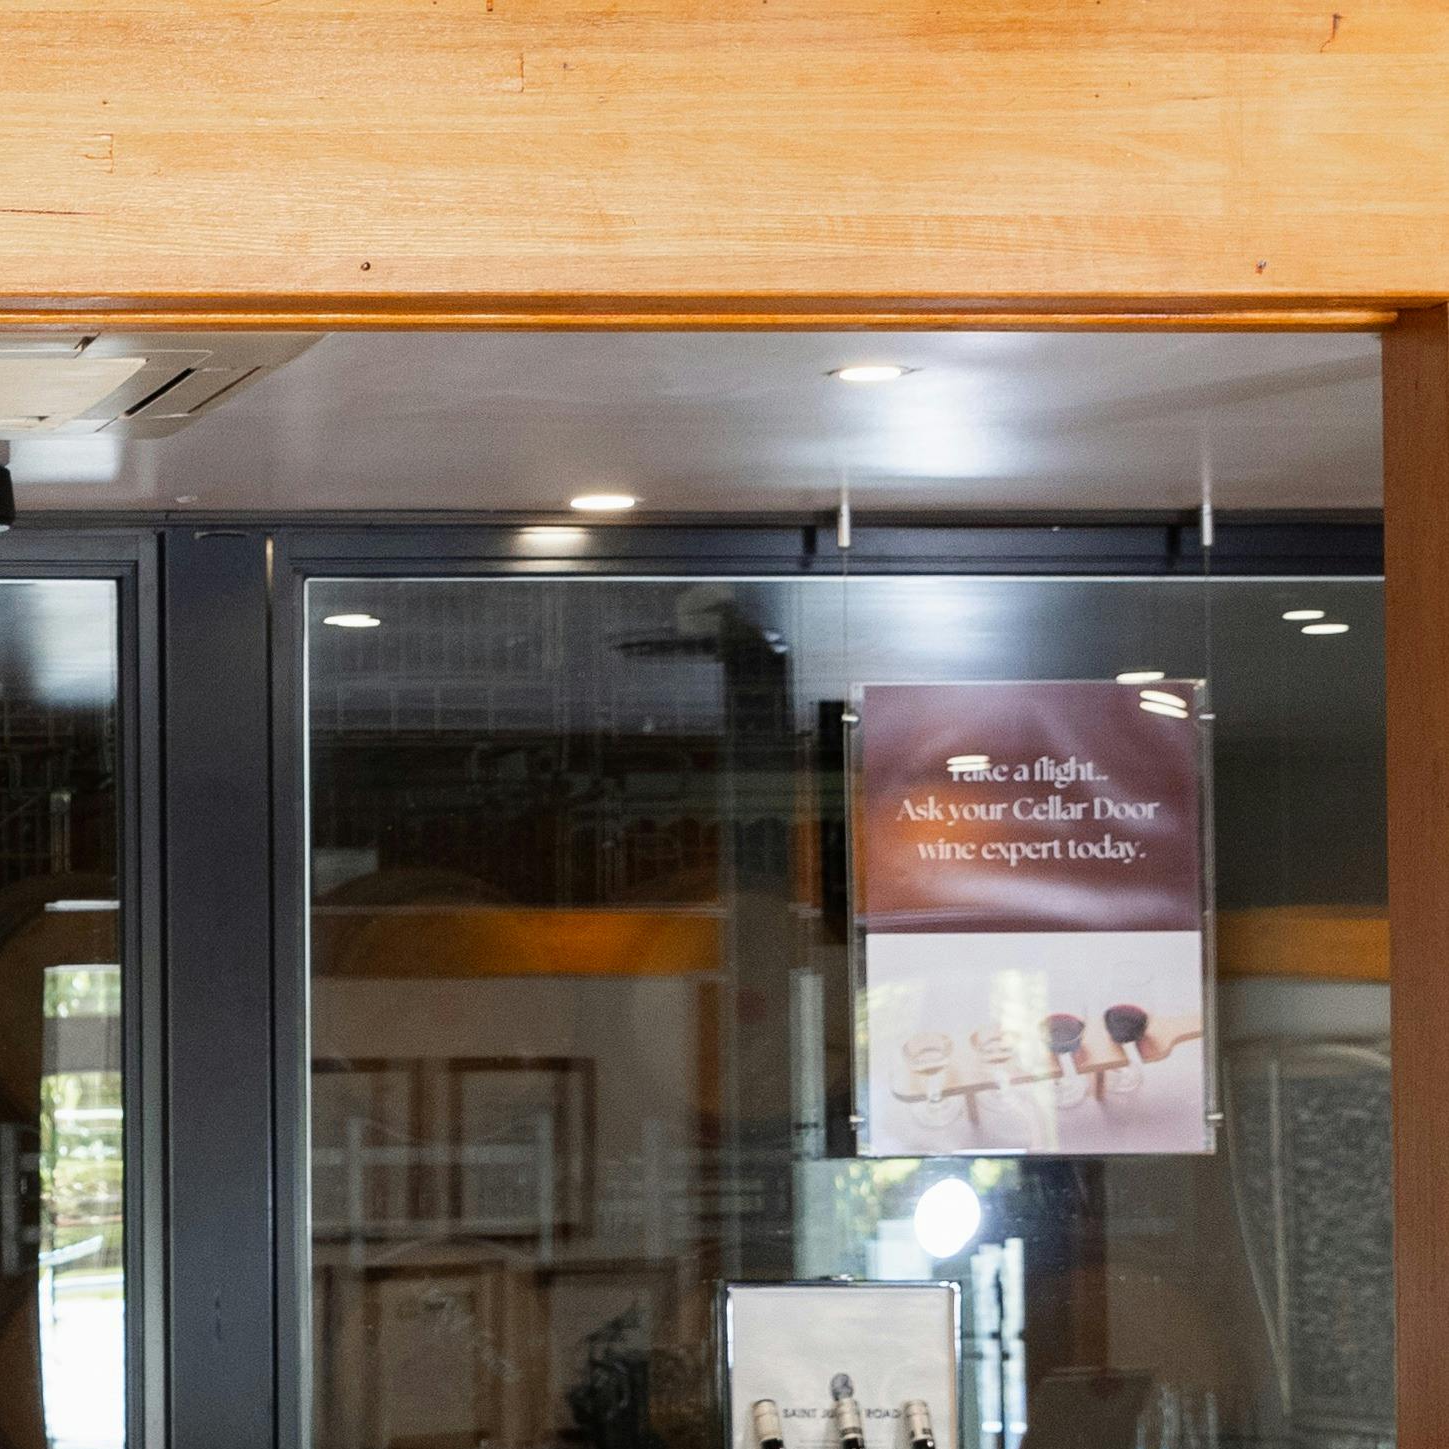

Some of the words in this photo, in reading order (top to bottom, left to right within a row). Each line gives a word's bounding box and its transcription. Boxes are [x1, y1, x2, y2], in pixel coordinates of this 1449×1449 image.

[1013, 763, 1030, 782] a
[896, 796, 945, 822] Ask
[946, 801, 1006, 826] your
[1013, 795, 1088, 821] Cellar
[1093, 798, 1160, 821] Door
[917, 837, 976, 860] wine
[981, 840, 1062, 867] expert
[1068, 834, 1147, 864] today.
